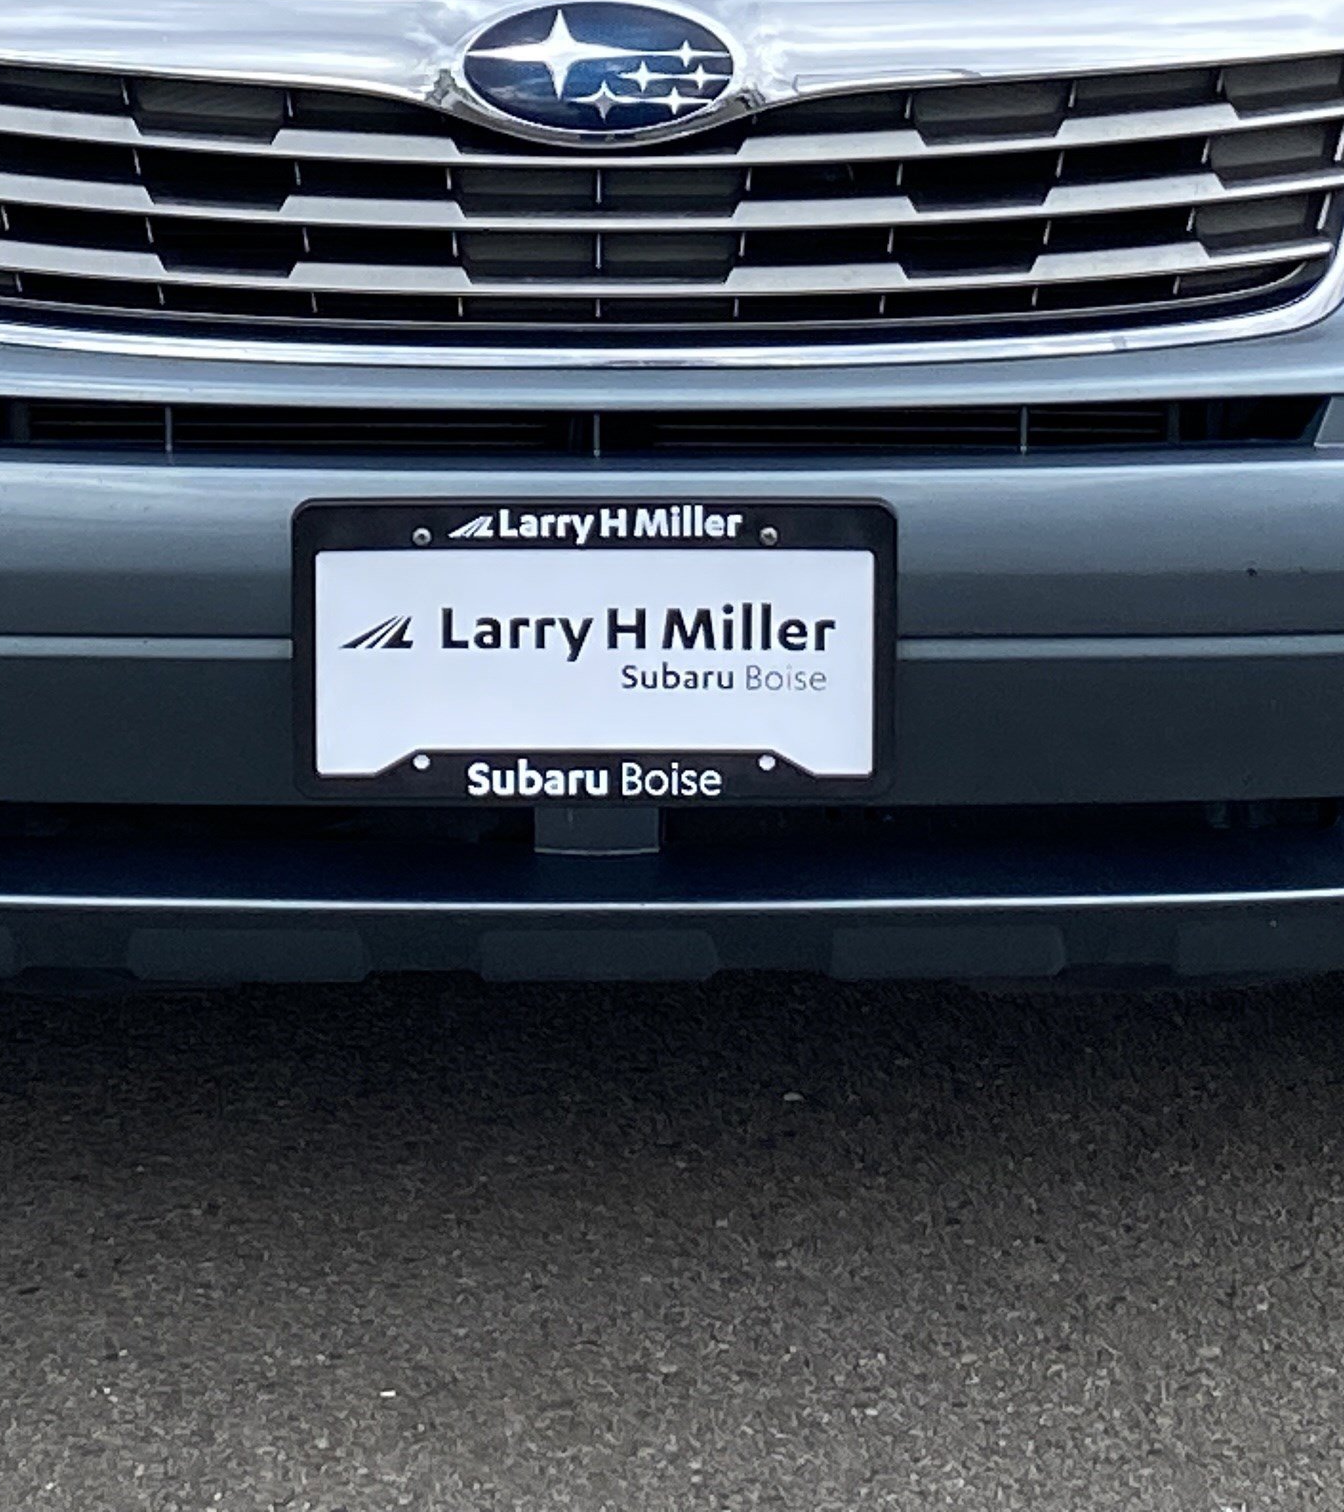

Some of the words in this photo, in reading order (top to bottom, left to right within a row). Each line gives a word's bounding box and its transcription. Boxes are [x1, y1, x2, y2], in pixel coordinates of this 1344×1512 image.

[499, 509, 595, 545] Larry
[600, 509, 628, 537] H
[634, 505, 743, 537] Miller
[440, 606, 594, 662] Larry
[606, 607, 647, 650] H
[662, 603, 836, 651] Miller
[621, 661, 735, 690] Subaru
[745, 665, 828, 691] Boise
[467, 758, 608, 796] Subaru
[621, 762, 723, 796] Boise
